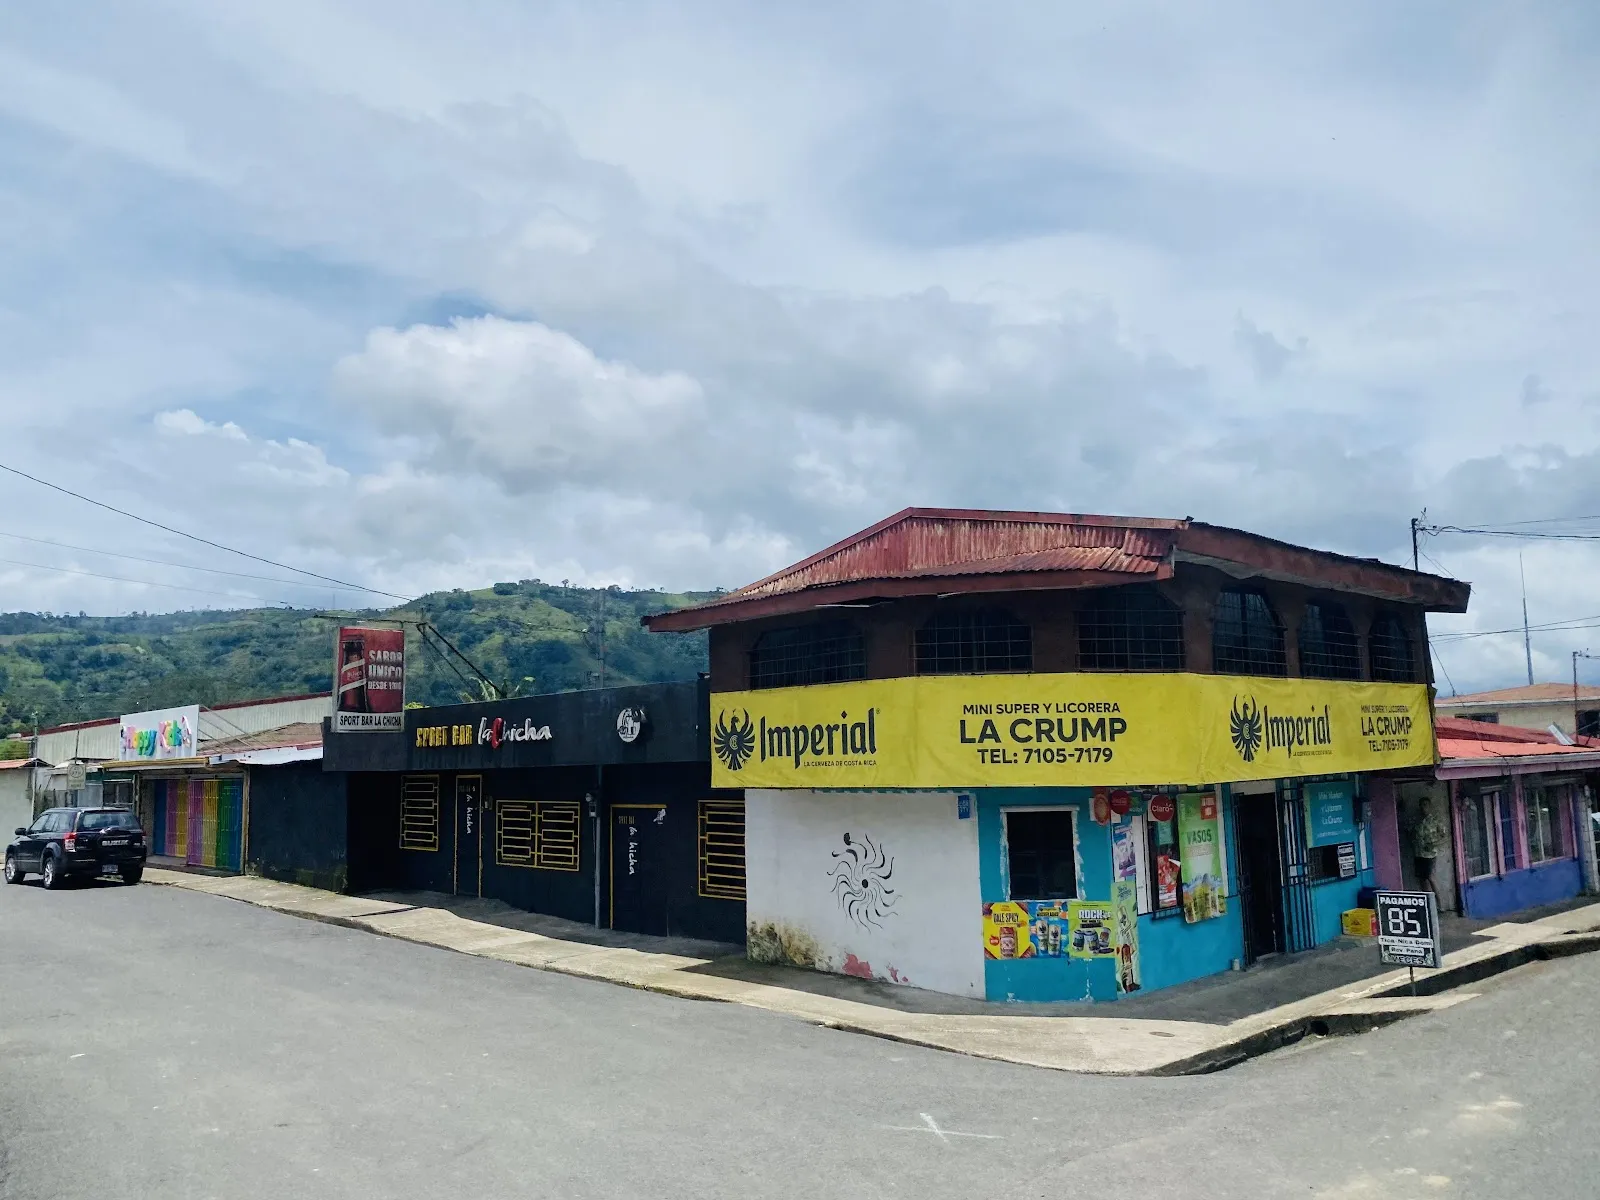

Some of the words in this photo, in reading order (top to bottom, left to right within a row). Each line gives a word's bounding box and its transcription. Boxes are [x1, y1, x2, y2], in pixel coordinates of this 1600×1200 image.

[369, 650, 402, 663] SABOR
[964, 704, 992, 715] MINI
[996, 703, 1039, 714] SUPER
[1043, 703, 1053, 713] Y
[1056, 703, 1121, 713] LICORERA
[340, 716, 360, 726] SPORT
[362, 716, 374, 725] BAR
[375, 716, 382, 725] LA
[1361, 717, 1375, 736] LA
[1377, 716, 1412, 736] CRUMP
[416, 726, 448, 748] SPORT
[452, 725, 473, 746] BAR
[760, 707, 877, 769] Imperial
[960, 719, 1002, 744] LA
[1010, 718, 1127, 743] CRUMP
[1264, 704, 1332, 759] Imperial
[977, 749, 1018, 764] TEL:
[1023, 748, 1113, 763] 7105-7179
[1151, 804, 1169, 812] Claro
[1187, 829, 1212, 845] VASOS
[1380, 897, 1425, 906] PAGAMOS
[1388, 908, 1421, 935] 85
[1391, 955, 1424, 965] VECES
